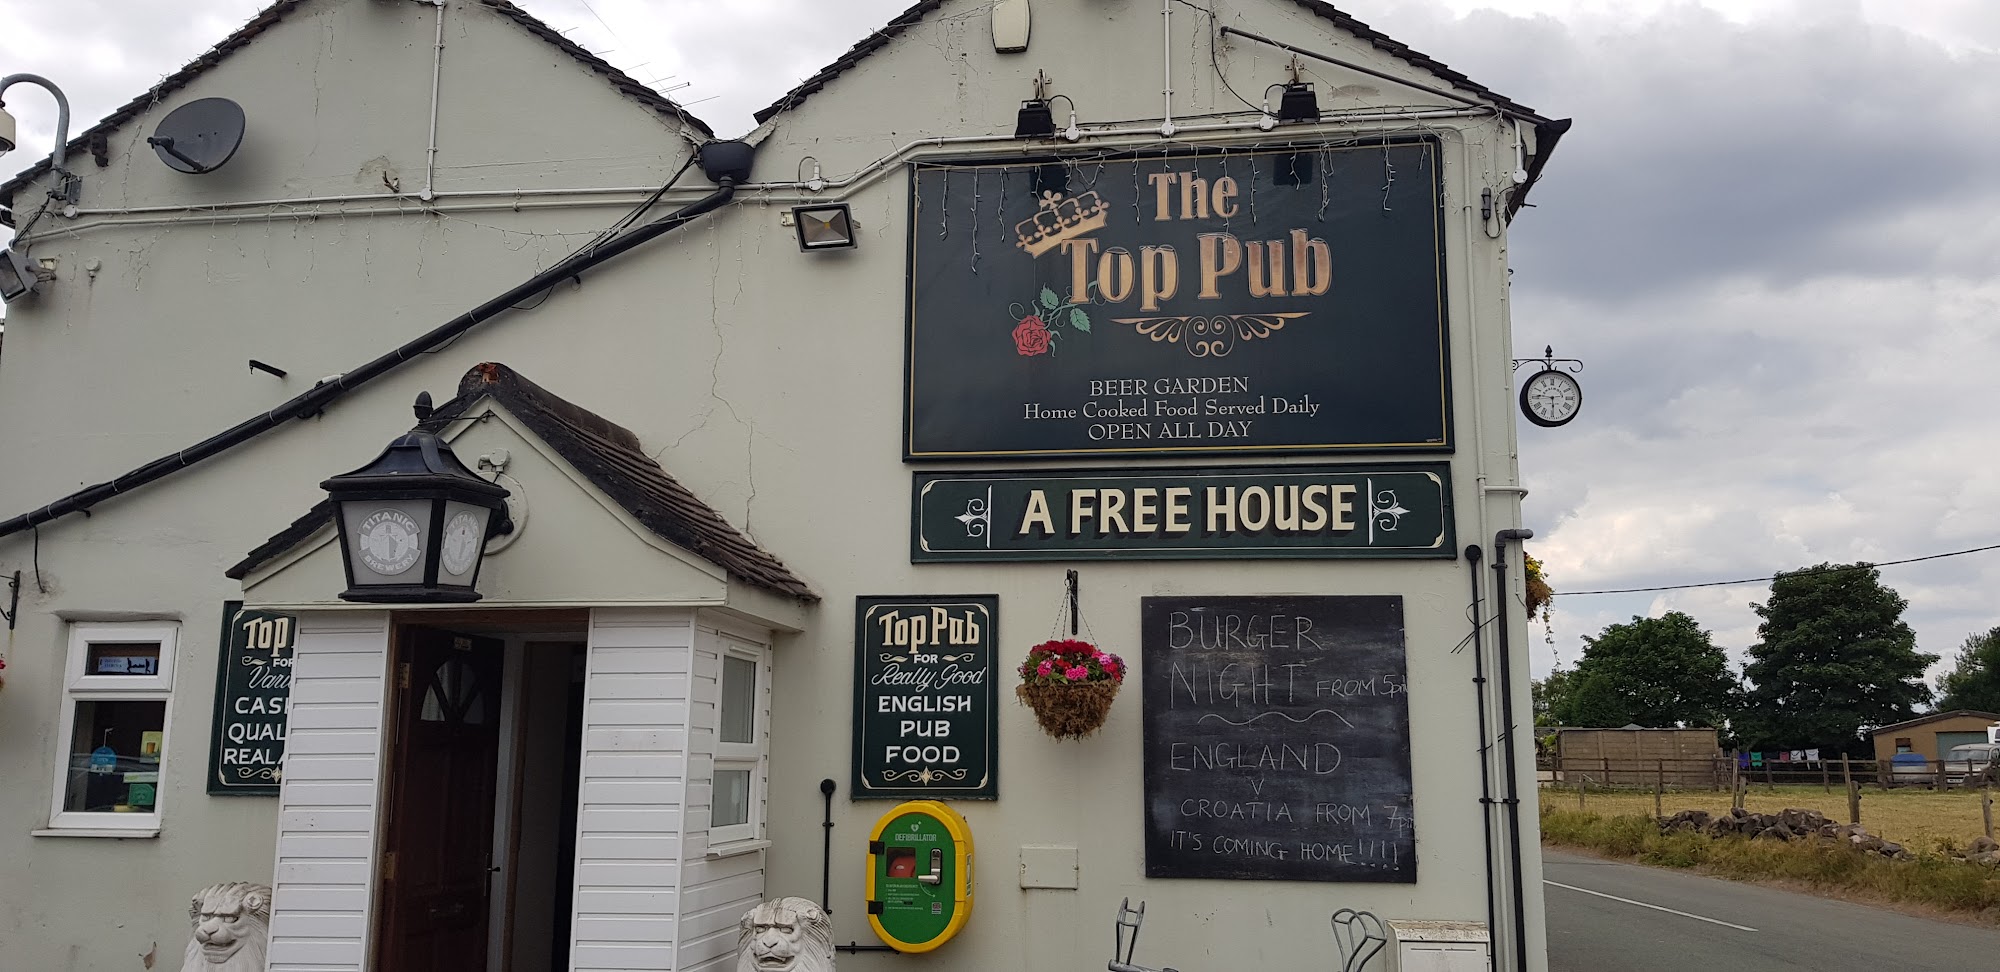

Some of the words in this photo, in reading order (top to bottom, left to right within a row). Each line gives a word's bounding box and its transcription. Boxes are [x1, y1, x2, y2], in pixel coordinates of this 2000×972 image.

[1148, 171, 1239, 221] The
[1060, 238, 1179, 312] Top
[1197, 228, 1332, 299] Pub
[1090, 379, 1148, 396] BEER
[1154, 376, 1249, 395] GARDEN
[1024, 403, 1077, 419] Home
[1082, 399, 1148, 418] Cooked
[1154, 397, 1198, 417] Food
[1205, 395, 1266, 416] Served
[1271, 394, 1320, 417] Daily
[1088, 423, 1152, 440] OPEN
[1158, 422, 1201, 439] ALL
[1208, 420, 1252, 438] DAY
[362, 511, 416, 531] TITANIC
[1019, 489, 1055, 534] A
[1071, 487, 1193, 534] FREE
[1206, 484, 1356, 532] HOUSE
[364, 554, 414, 571] BREWERY
[243, 616, 289, 657] Top
[879, 609, 927, 654] Top
[930, 606, 980, 645] Pub
[1169, 612, 1322, 650] BURGER
[914, 654, 938, 664] FOR
[871, 663, 937, 692] Really
[934, 664, 987, 690] Good
[1171, 662, 1307, 708] NIGHT
[1316, 678, 1375, 697] FROM
[878, 695, 971, 713] ENGLISH
[900, 720, 950, 737] PUB
[886, 746, 960, 763] FOOD
[1170, 743, 1341, 774] ENGLAND
[1180, 799, 1293, 823] CROATIA
[1316, 803, 1371, 826] FROM
[895, 833, 937, 842] DEFIBRILLATOR
[1170, 830, 1202, 851] IT'S
[1212, 835, 1288, 860] COMING
